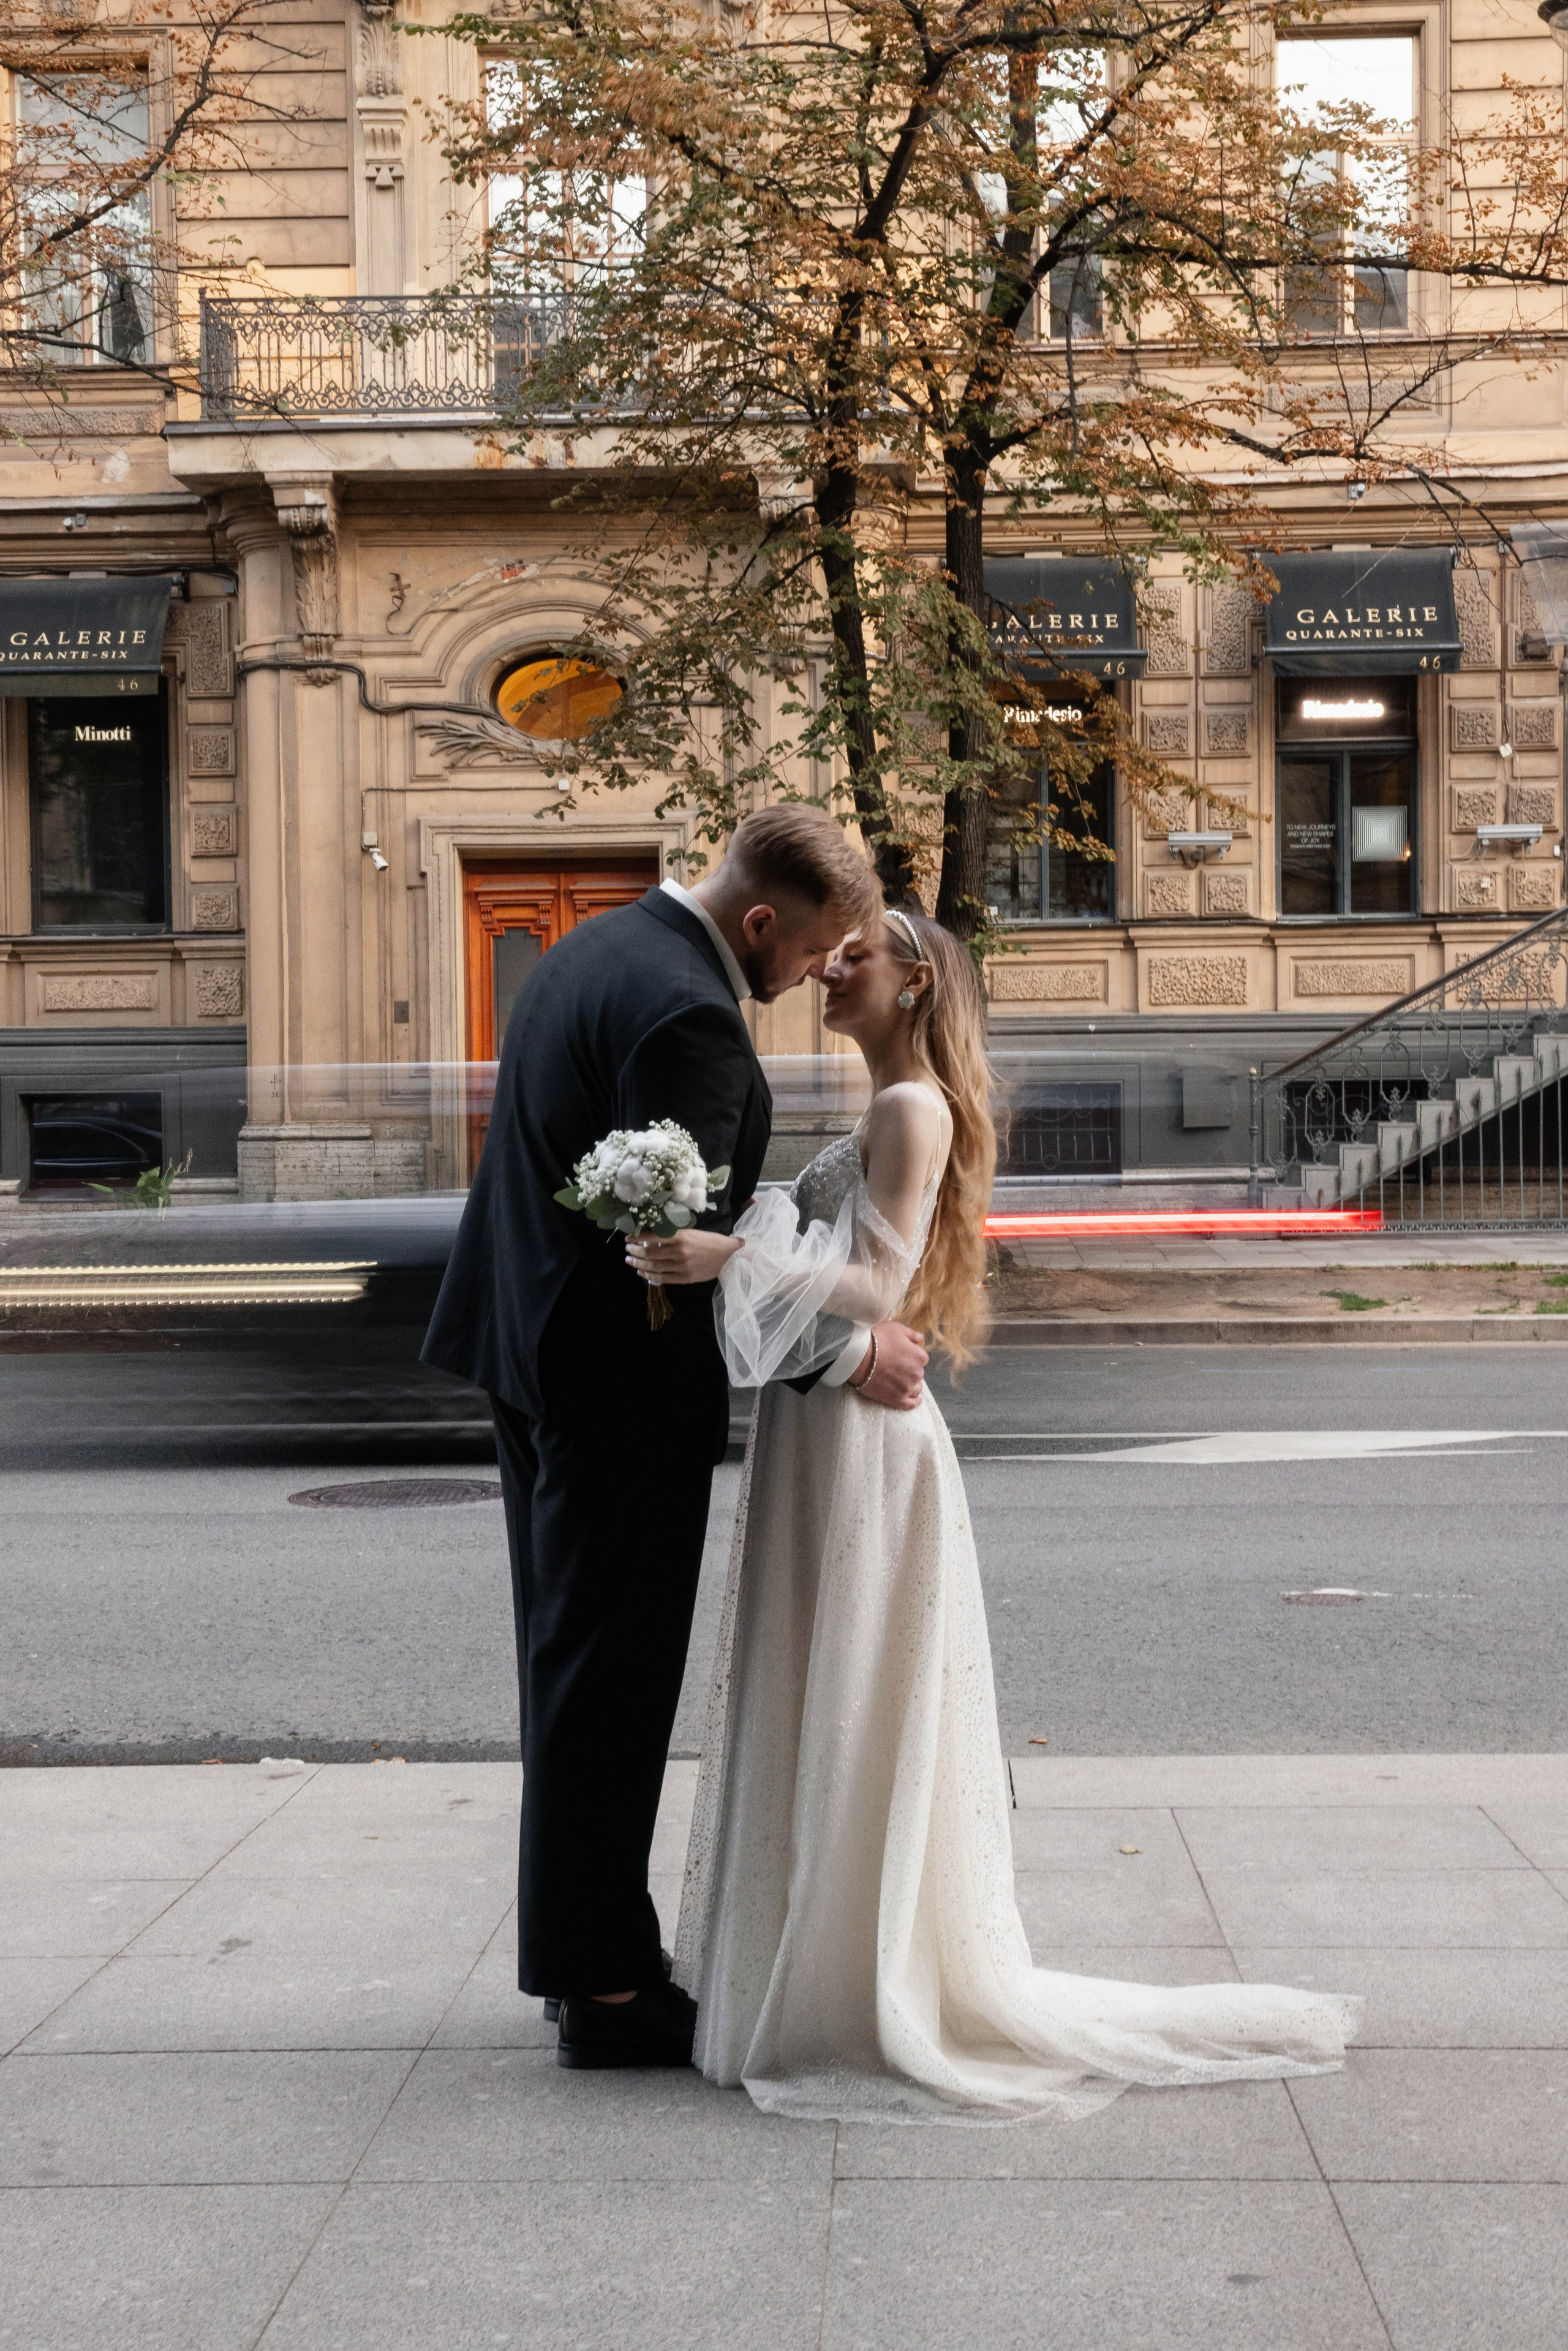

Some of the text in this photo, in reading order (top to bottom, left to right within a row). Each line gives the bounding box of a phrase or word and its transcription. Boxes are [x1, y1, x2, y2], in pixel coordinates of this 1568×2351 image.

[985, 614, 1118, 629] ALERIE
[1297, 606, 1438, 624] GALERIE
[10, 630, 146, 646] GALERIE
[1286, 627, 1424, 641] QUARANTE-SIX
[1103, 661, 1125, 675] 46
[1419, 655, 1441, 670] 46
[117, 677, 138, 691] 46
[74, 725, 131, 741] Minotti
